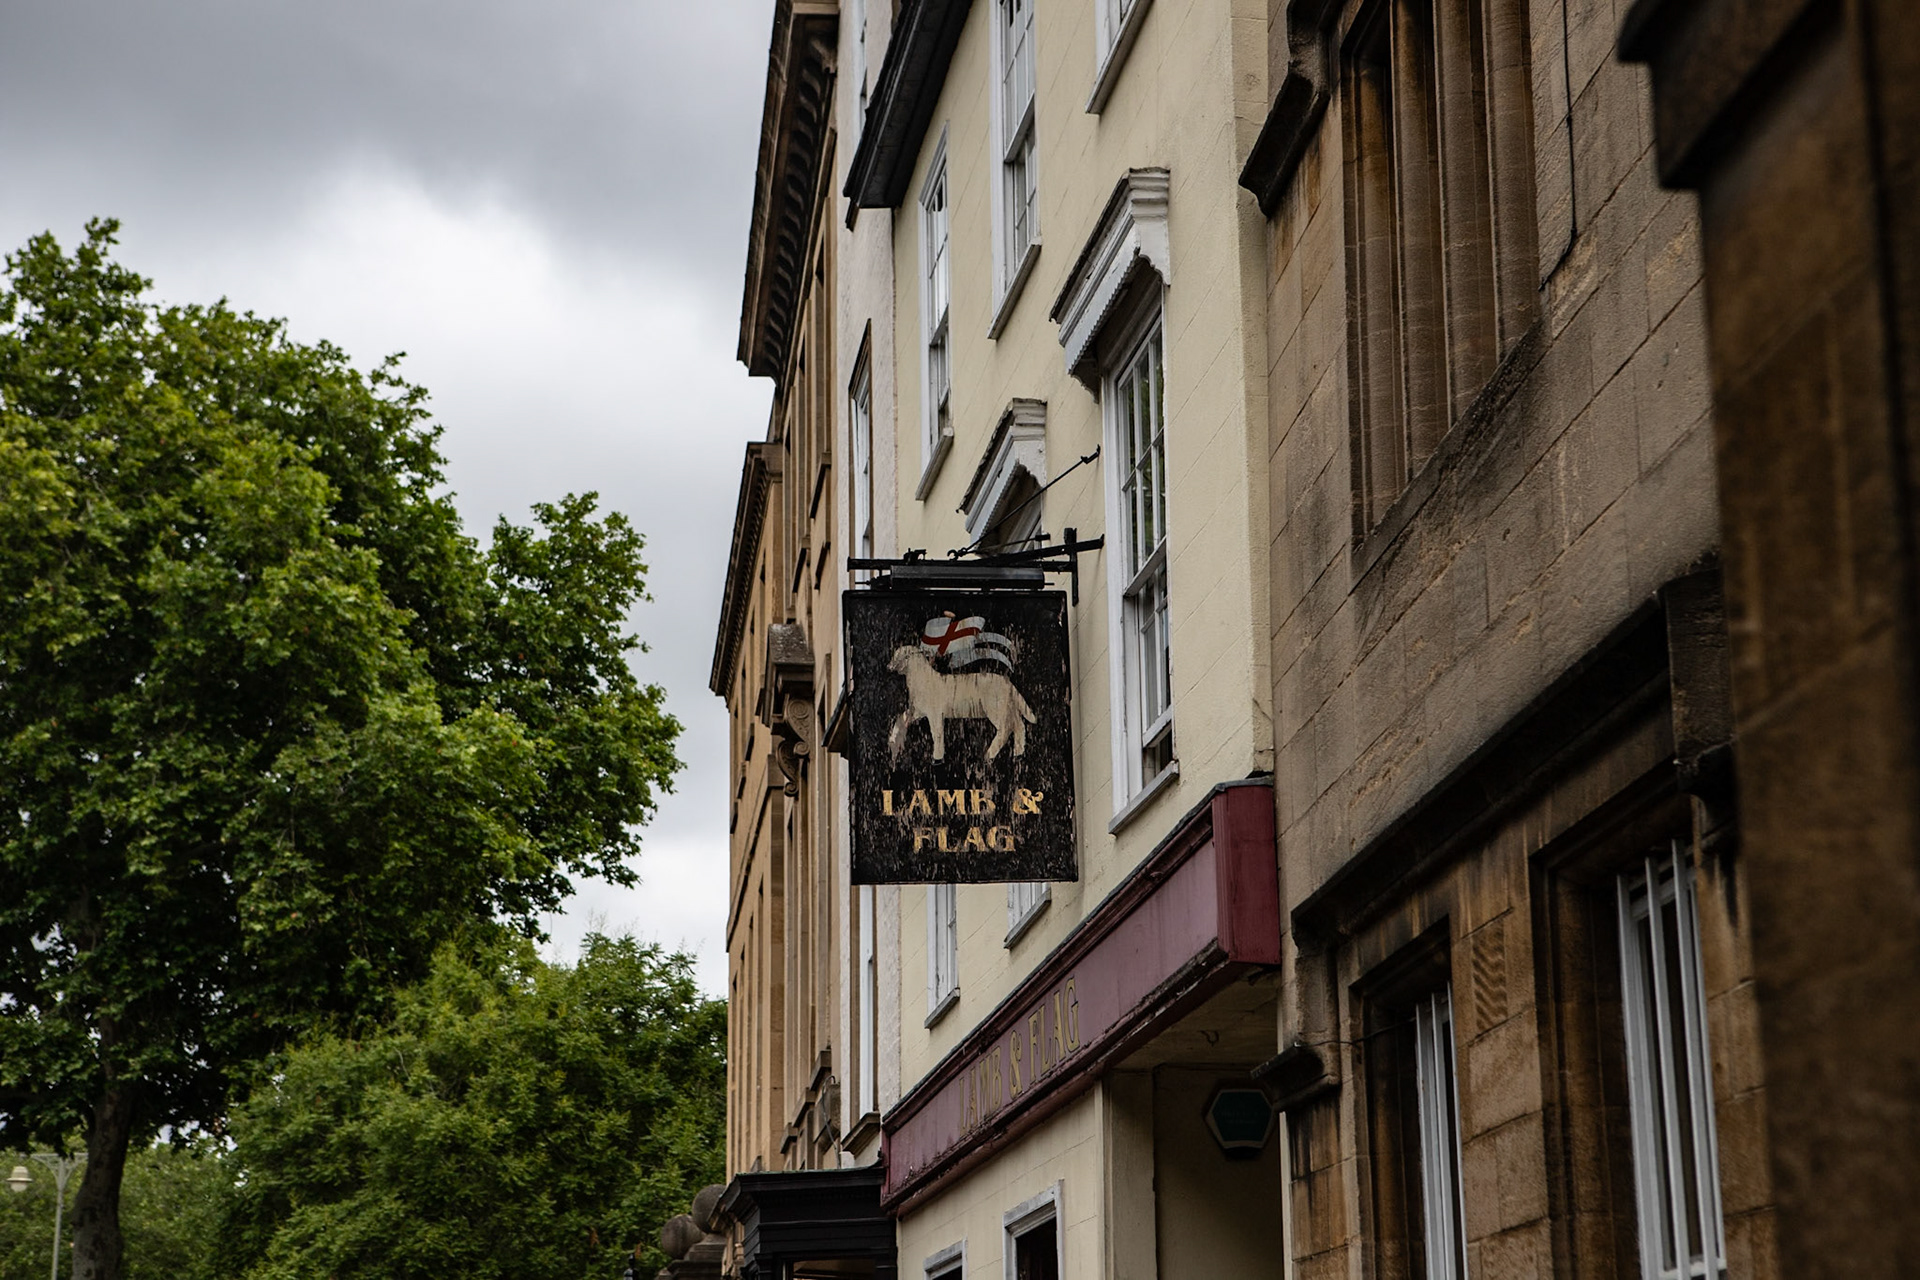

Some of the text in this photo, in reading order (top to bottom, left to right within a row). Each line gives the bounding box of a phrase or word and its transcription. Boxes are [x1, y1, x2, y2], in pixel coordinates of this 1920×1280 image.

[881, 788, 1045, 816] LAMB &
[912, 825, 1017, 854] FLAG
[959, 977, 1080, 1137] LAMB & FLAG
